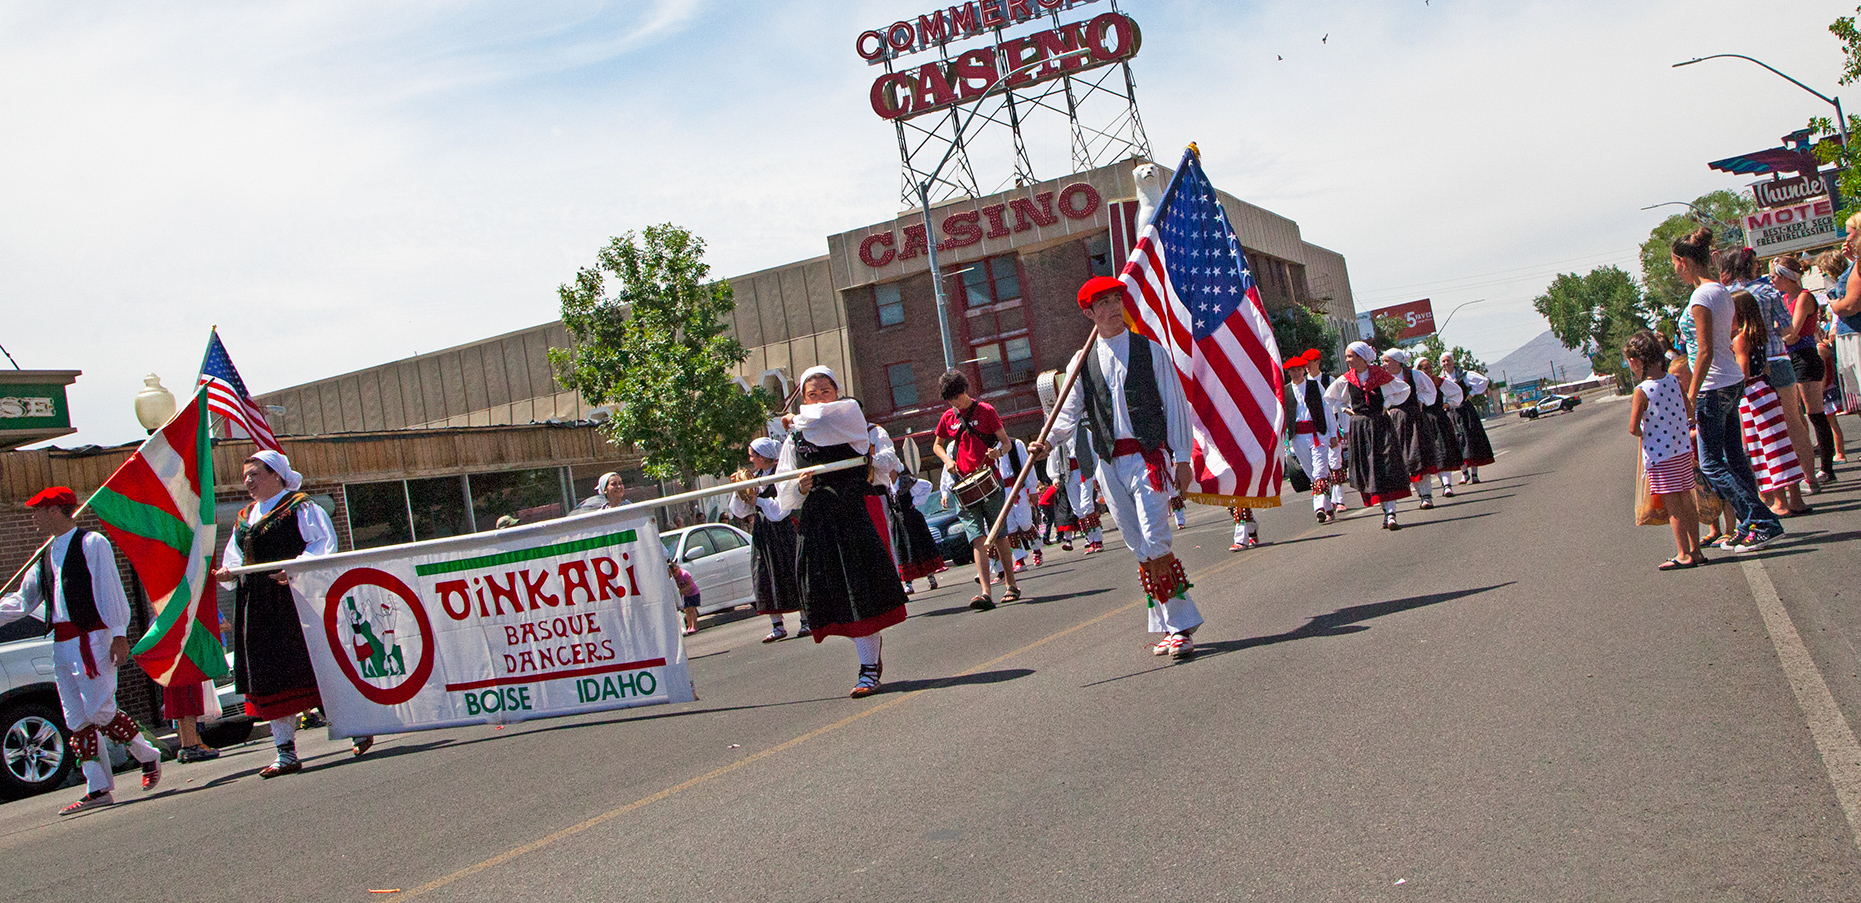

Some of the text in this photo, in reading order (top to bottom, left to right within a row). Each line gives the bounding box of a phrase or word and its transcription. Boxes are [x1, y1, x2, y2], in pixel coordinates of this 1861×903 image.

[869, 12, 1133, 121] CASINO
[1746, 175, 1828, 206] Thunder
[859, 182, 1101, 267] CASINO
[1747, 200, 1833, 231] MOTE
[1763, 216, 1834, 239] BEST-KEPT SECR
[1756, 225, 1836, 247] FREEWIRELESSINTE
[0, 396, 56, 418] SE
[505, 612, 601, 646] BASQUE
[503, 639, 615, 674] DANCERS
[465, 671, 657, 716] BOISE IDAHO
